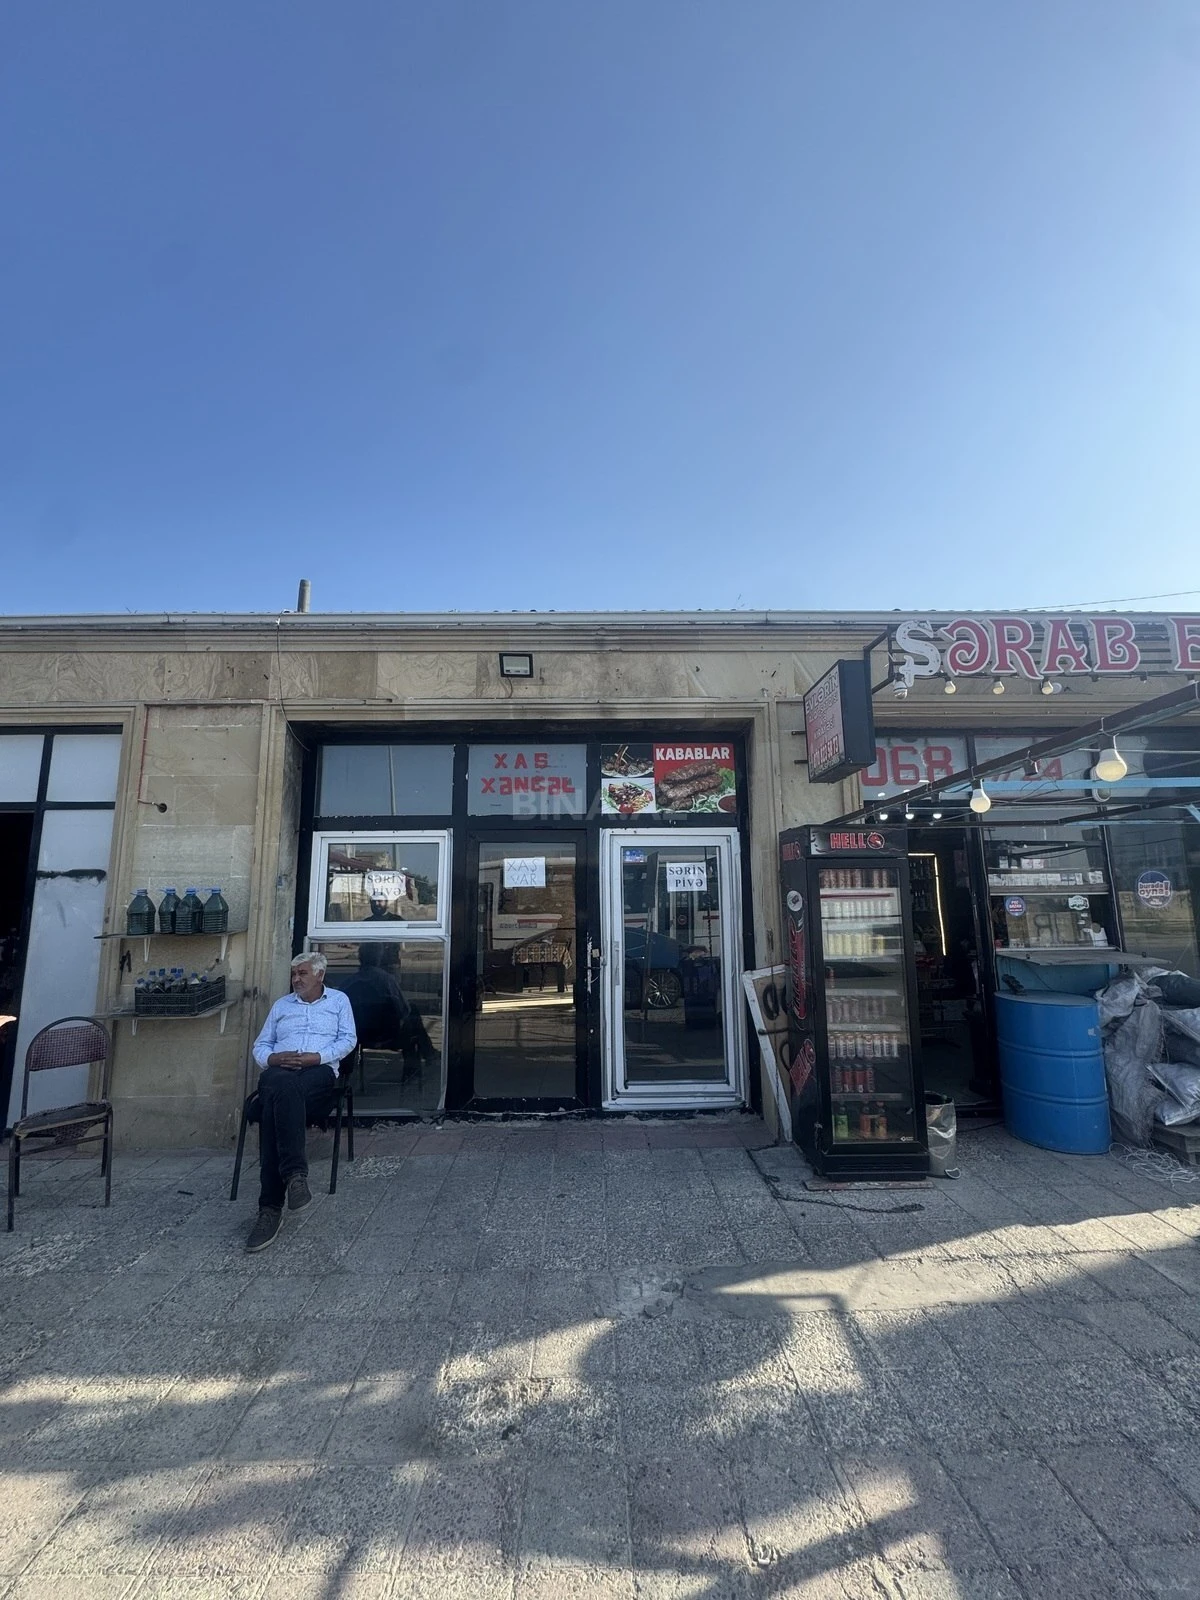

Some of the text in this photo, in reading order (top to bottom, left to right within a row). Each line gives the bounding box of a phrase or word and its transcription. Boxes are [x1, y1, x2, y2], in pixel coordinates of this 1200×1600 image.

[655, 746, 730, 761] KABABLAR
[829, 832, 867, 849] HELL
[669, 864, 704, 875] SƏRİN
[367, 873, 405, 884] SƏRİN
[675, 877, 703, 888] PİVƏ
[372, 885, 402, 896] PİVƏ
